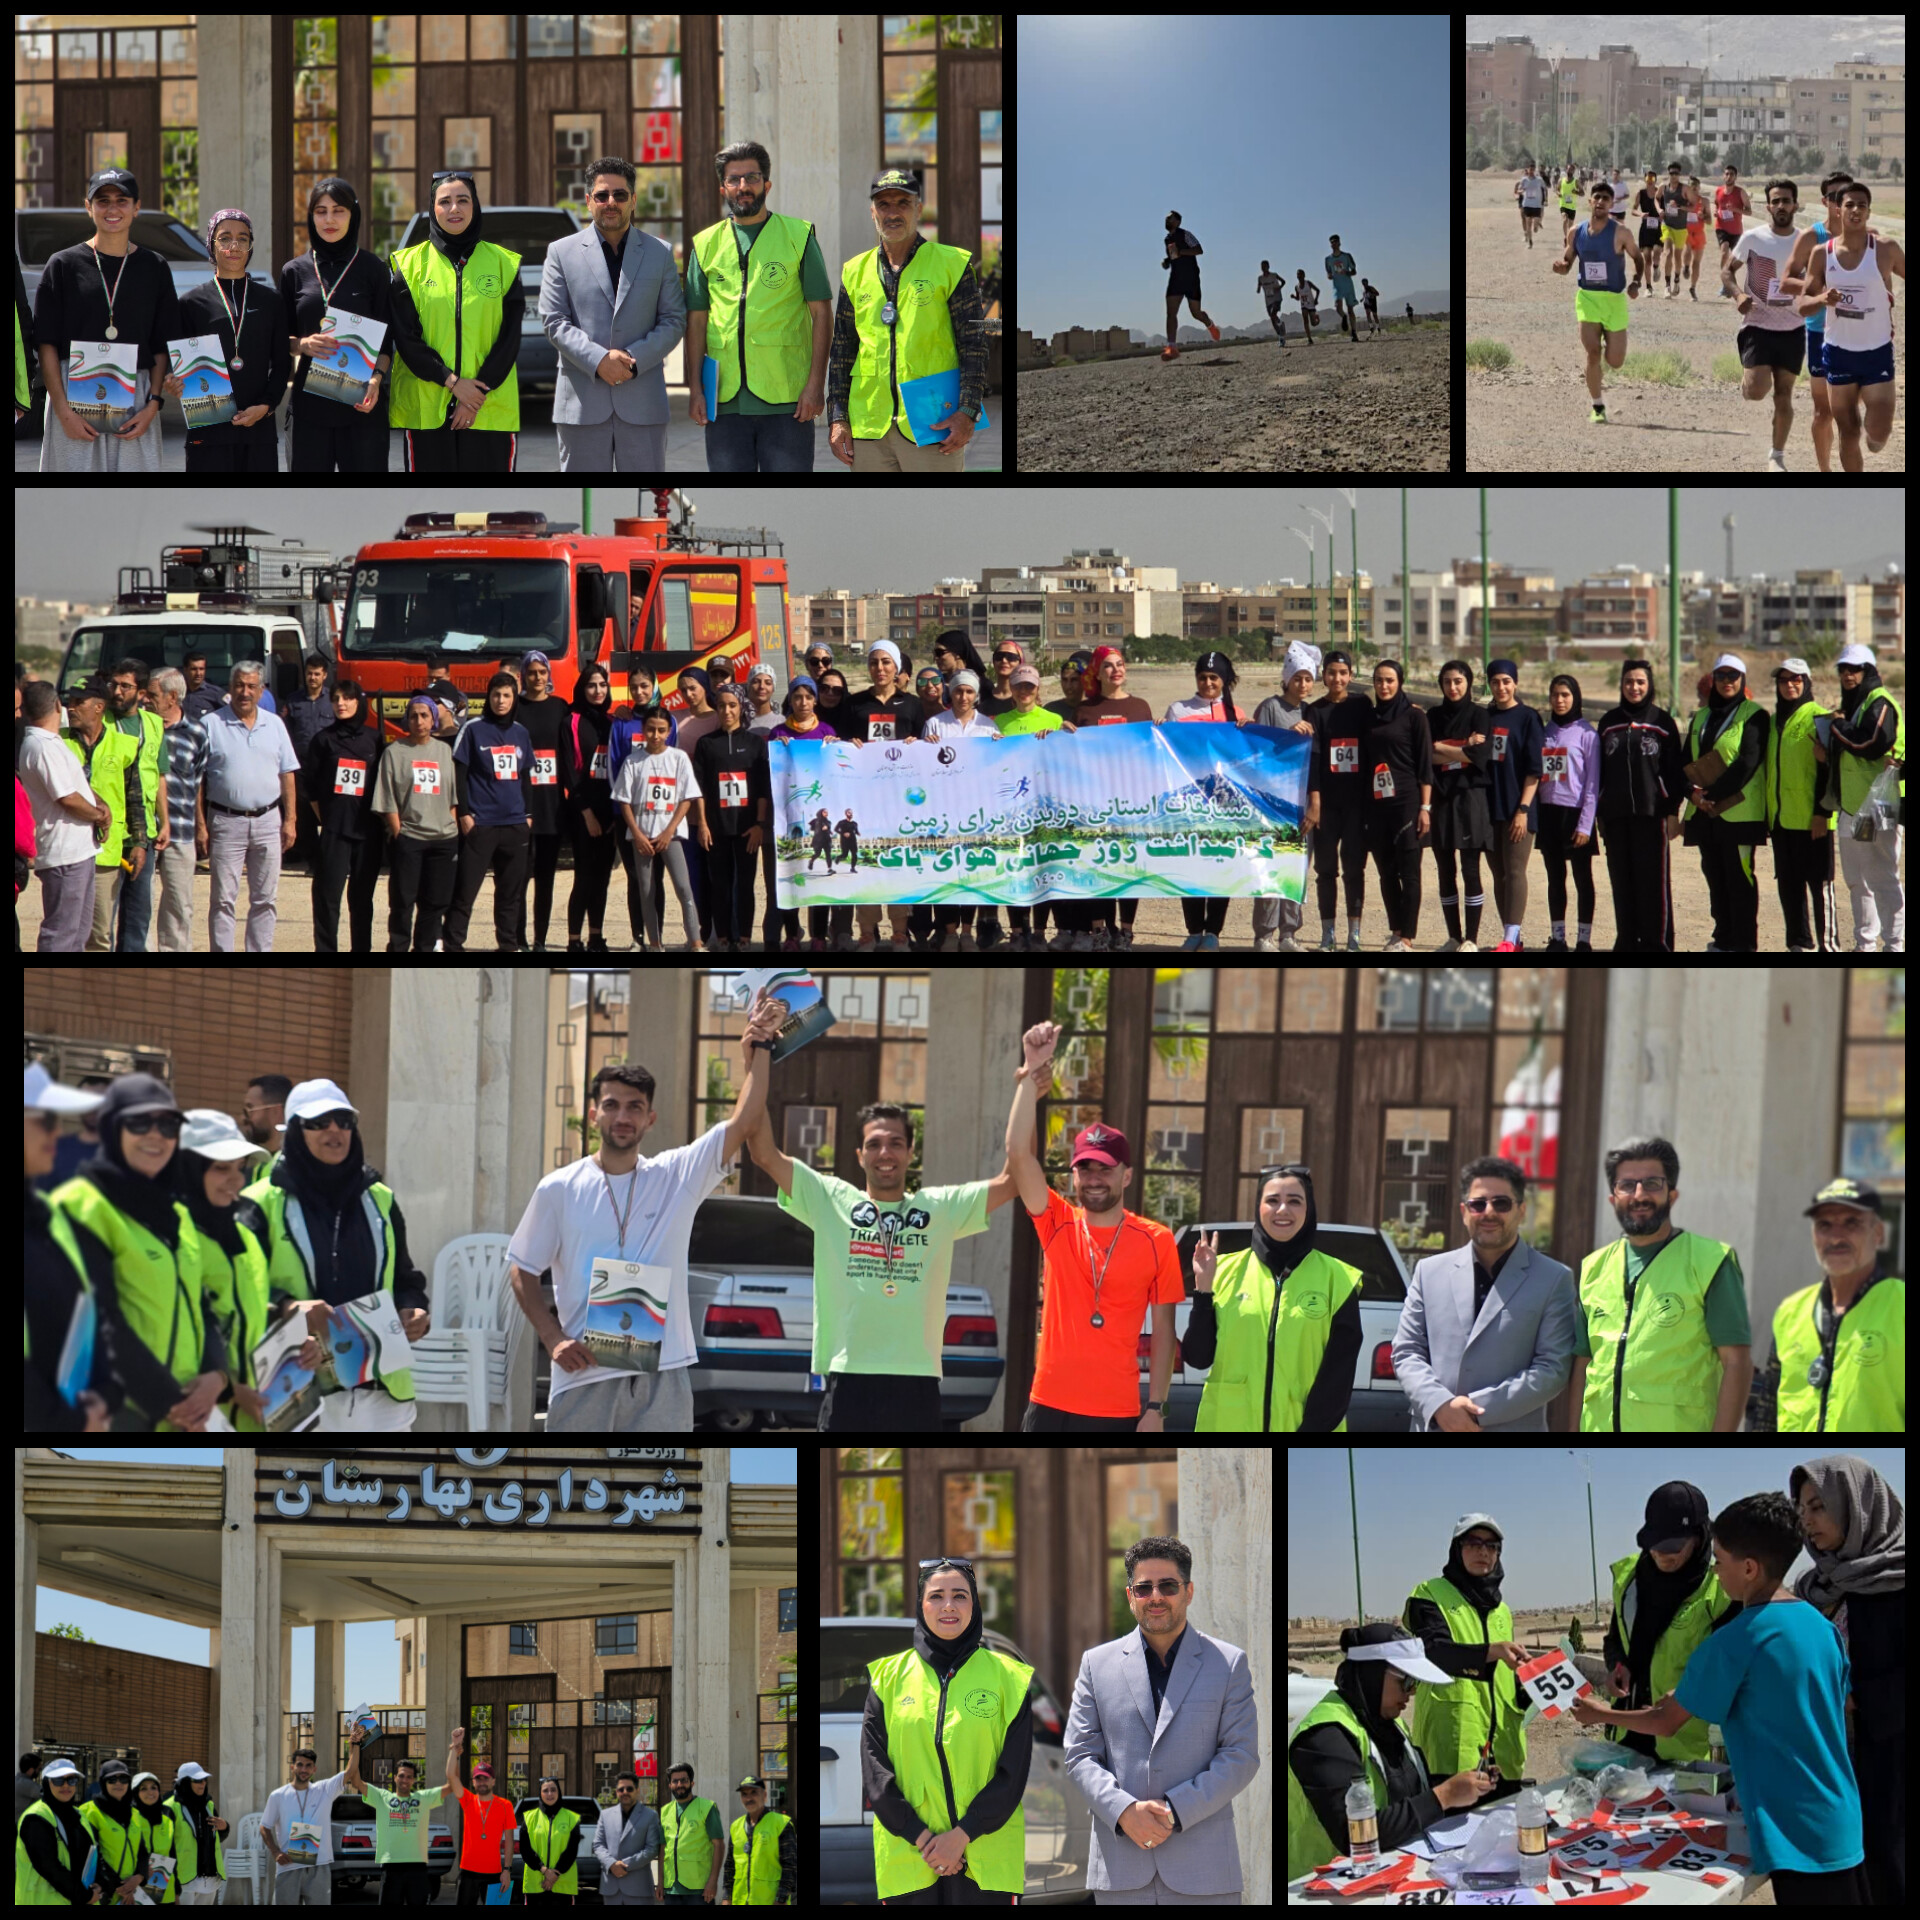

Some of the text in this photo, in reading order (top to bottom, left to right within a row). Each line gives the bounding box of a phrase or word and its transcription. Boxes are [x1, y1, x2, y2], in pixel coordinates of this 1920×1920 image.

[356, 569, 379, 588] 93
[761, 624, 782, 650] 125
[872, 723, 891, 737] 26
[498, 755, 513, 769] 57
[1336, 748, 1354, 762] 64
[1547, 756, 1563, 771] 36
[341, 769, 361, 784] 39
[418, 769, 436, 783] 59
[534, 759, 552, 774] 63
[652, 785, 671, 801] 60
[725, 782, 740, 796] 11
[898, 794, 1251, 834] مسابقات استانی دویدن برای زمین
[878, 846, 922, 875] پاک
[933, 845, 997, 872] هوای
[1005, 843, 1082, 872] جهانی
[1092, 839, 1137, 864] روز
[273, 1459, 685, 1528] شهرداری بهارستان
[1533, 1665, 1575, 1701] 55
[1562, 1835, 1609, 1857] 55
[1668, 1848, 1718, 1872] 83
